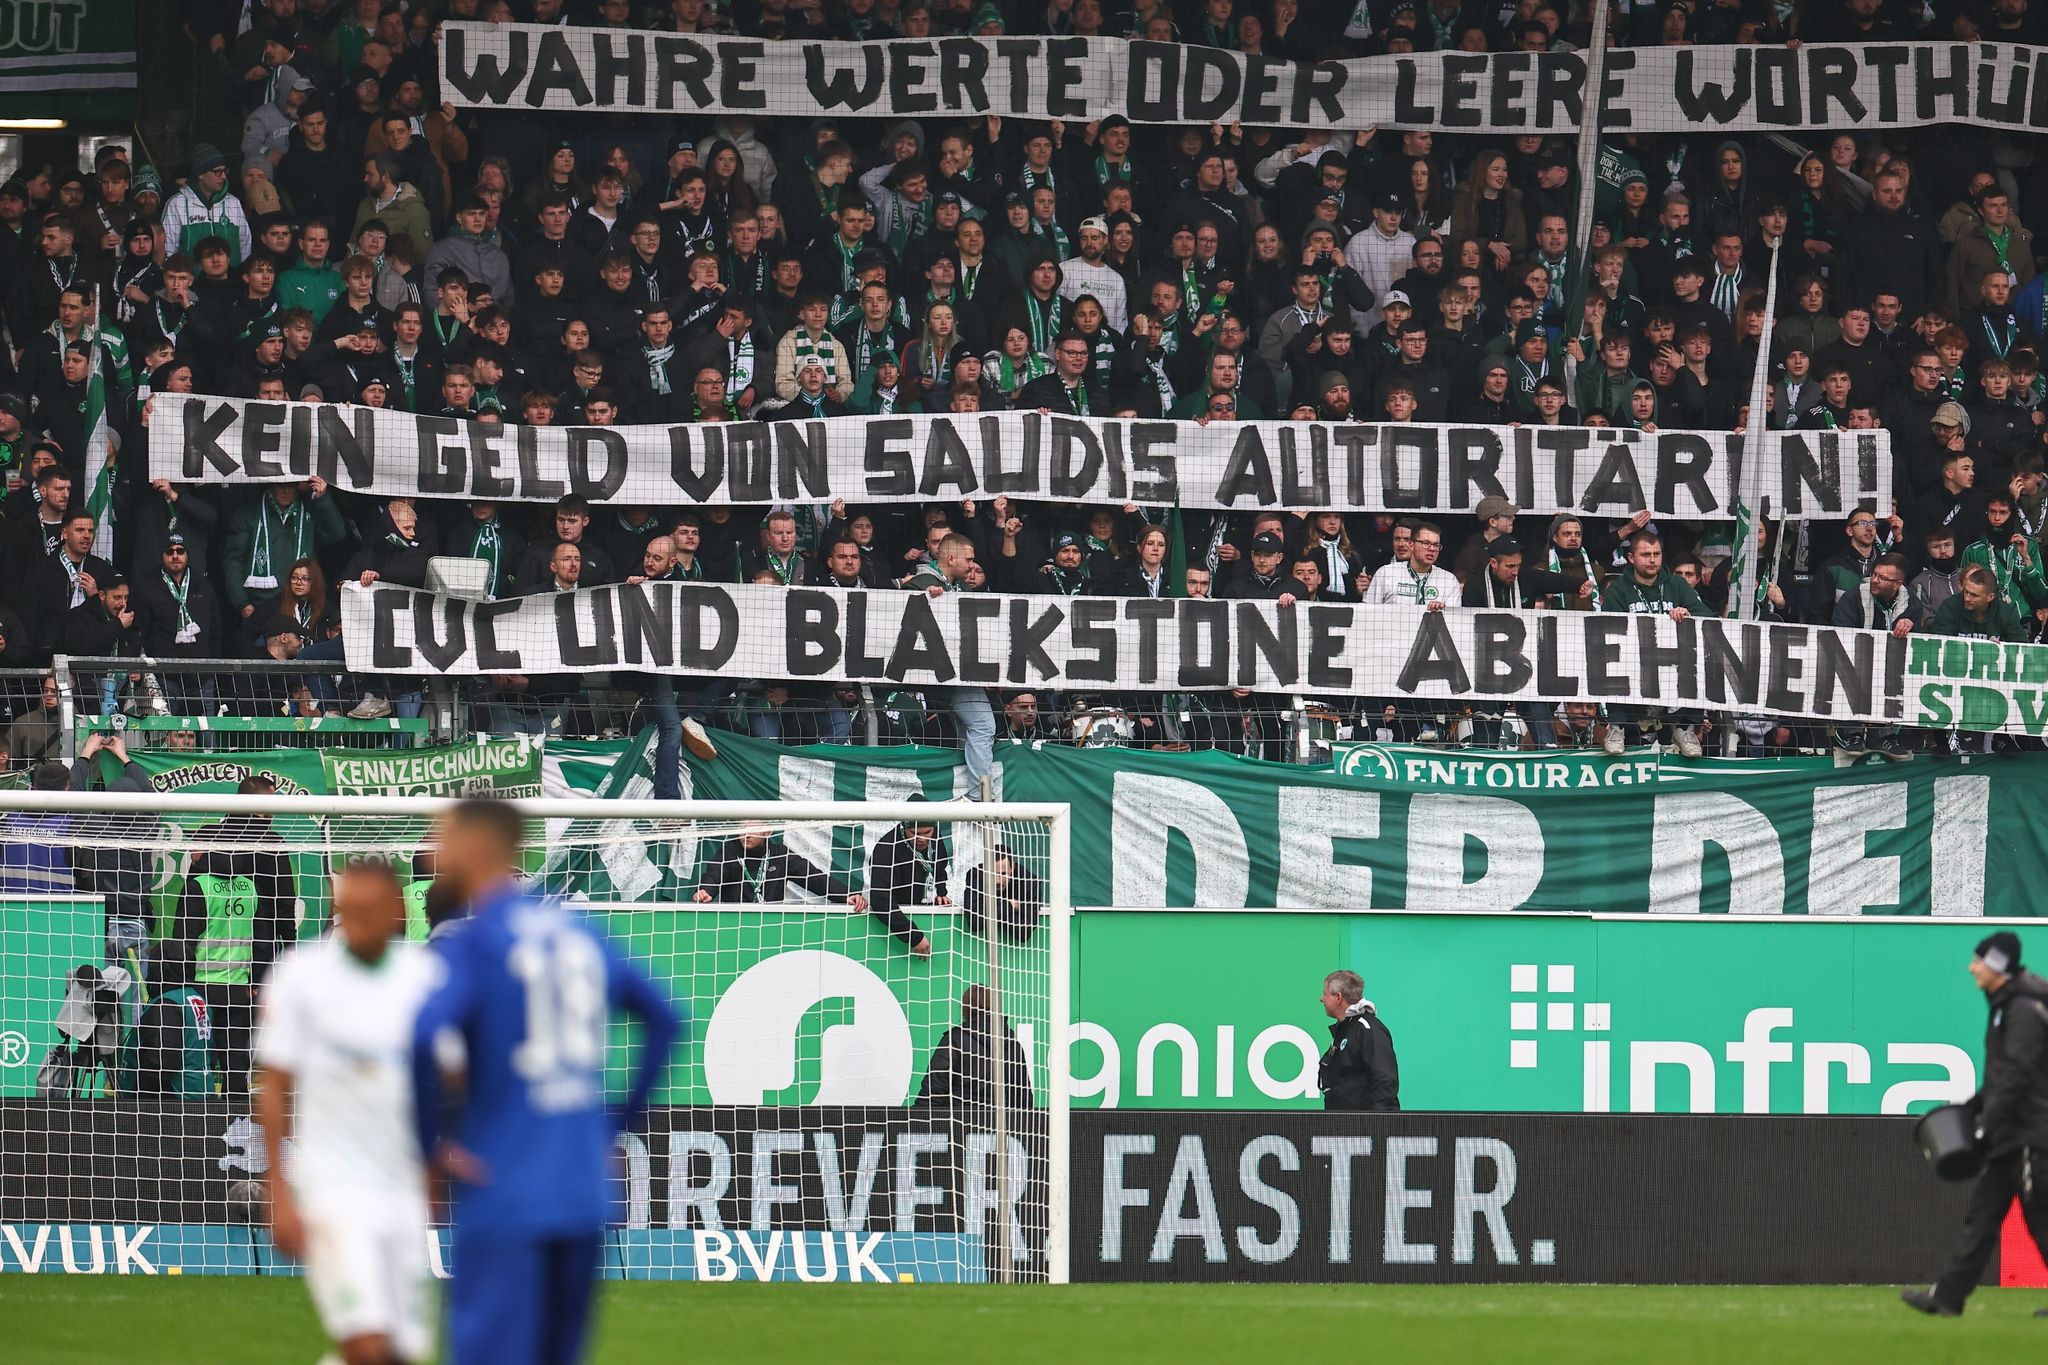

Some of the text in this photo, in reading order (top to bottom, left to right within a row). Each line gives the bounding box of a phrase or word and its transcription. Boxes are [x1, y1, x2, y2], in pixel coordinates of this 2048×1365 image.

[446, 28, 2048, 127] WAHRE WERTE ODER LEERE WORTHÜ
[182, 398, 375, 489] KEIN
[416, 414, 628, 501] GELD
[669, 420, 830, 503] VON
[864, 412, 1177, 502] SAUDIS
[554, 583, 739, 672] UND
[785, 588, 1354, 689] BLACKSTONE
[1395, 612, 1908, 720] ABLEHNEN!
[333, 744, 528, 785] KENNZEICHNUNGS
[1404, 758, 1657, 789] ENTOURAGE
[213, 879, 251, 894] ORDNER
[224, 897, 245, 917] 66
[1583, 1002, 1977, 1115] infra
[1100, 1133, 1557, 1266] FASTER.
